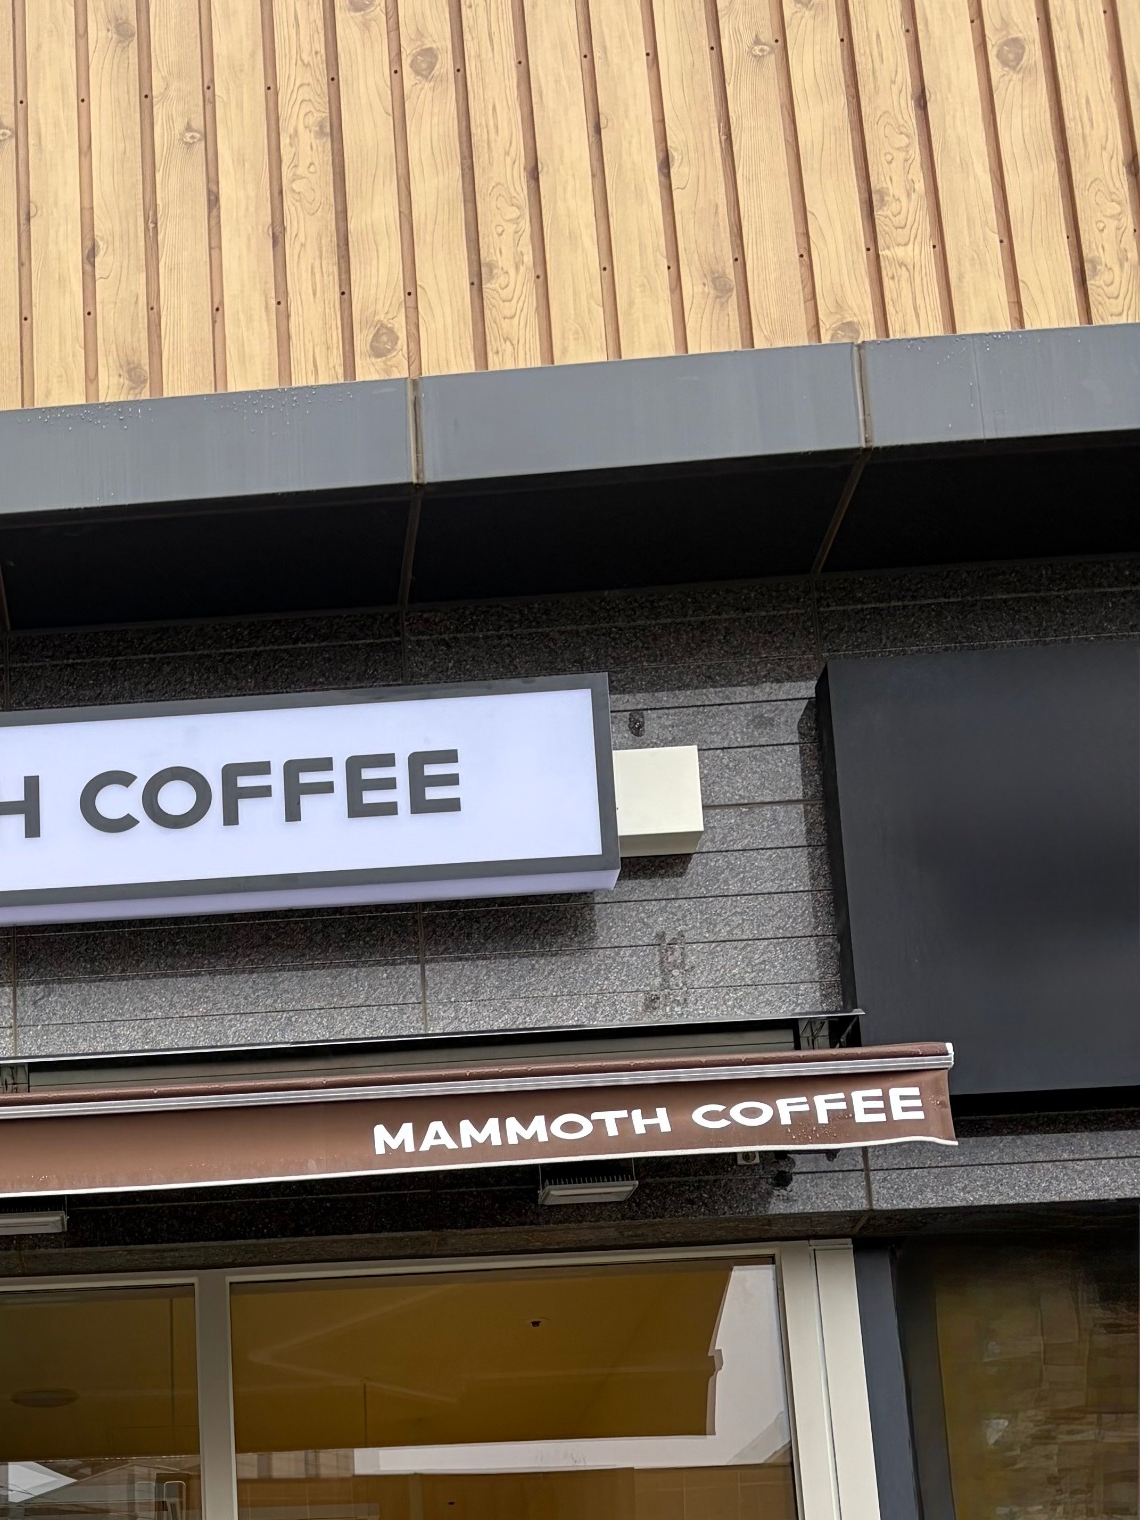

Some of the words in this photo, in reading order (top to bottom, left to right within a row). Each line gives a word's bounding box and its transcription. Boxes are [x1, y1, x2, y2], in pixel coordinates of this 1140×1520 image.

[80, 749, 460, 833] COFFEE
[373, 1107, 671, 1154] MAMMOTH
[691, 1087, 925, 1129] COFFEE
